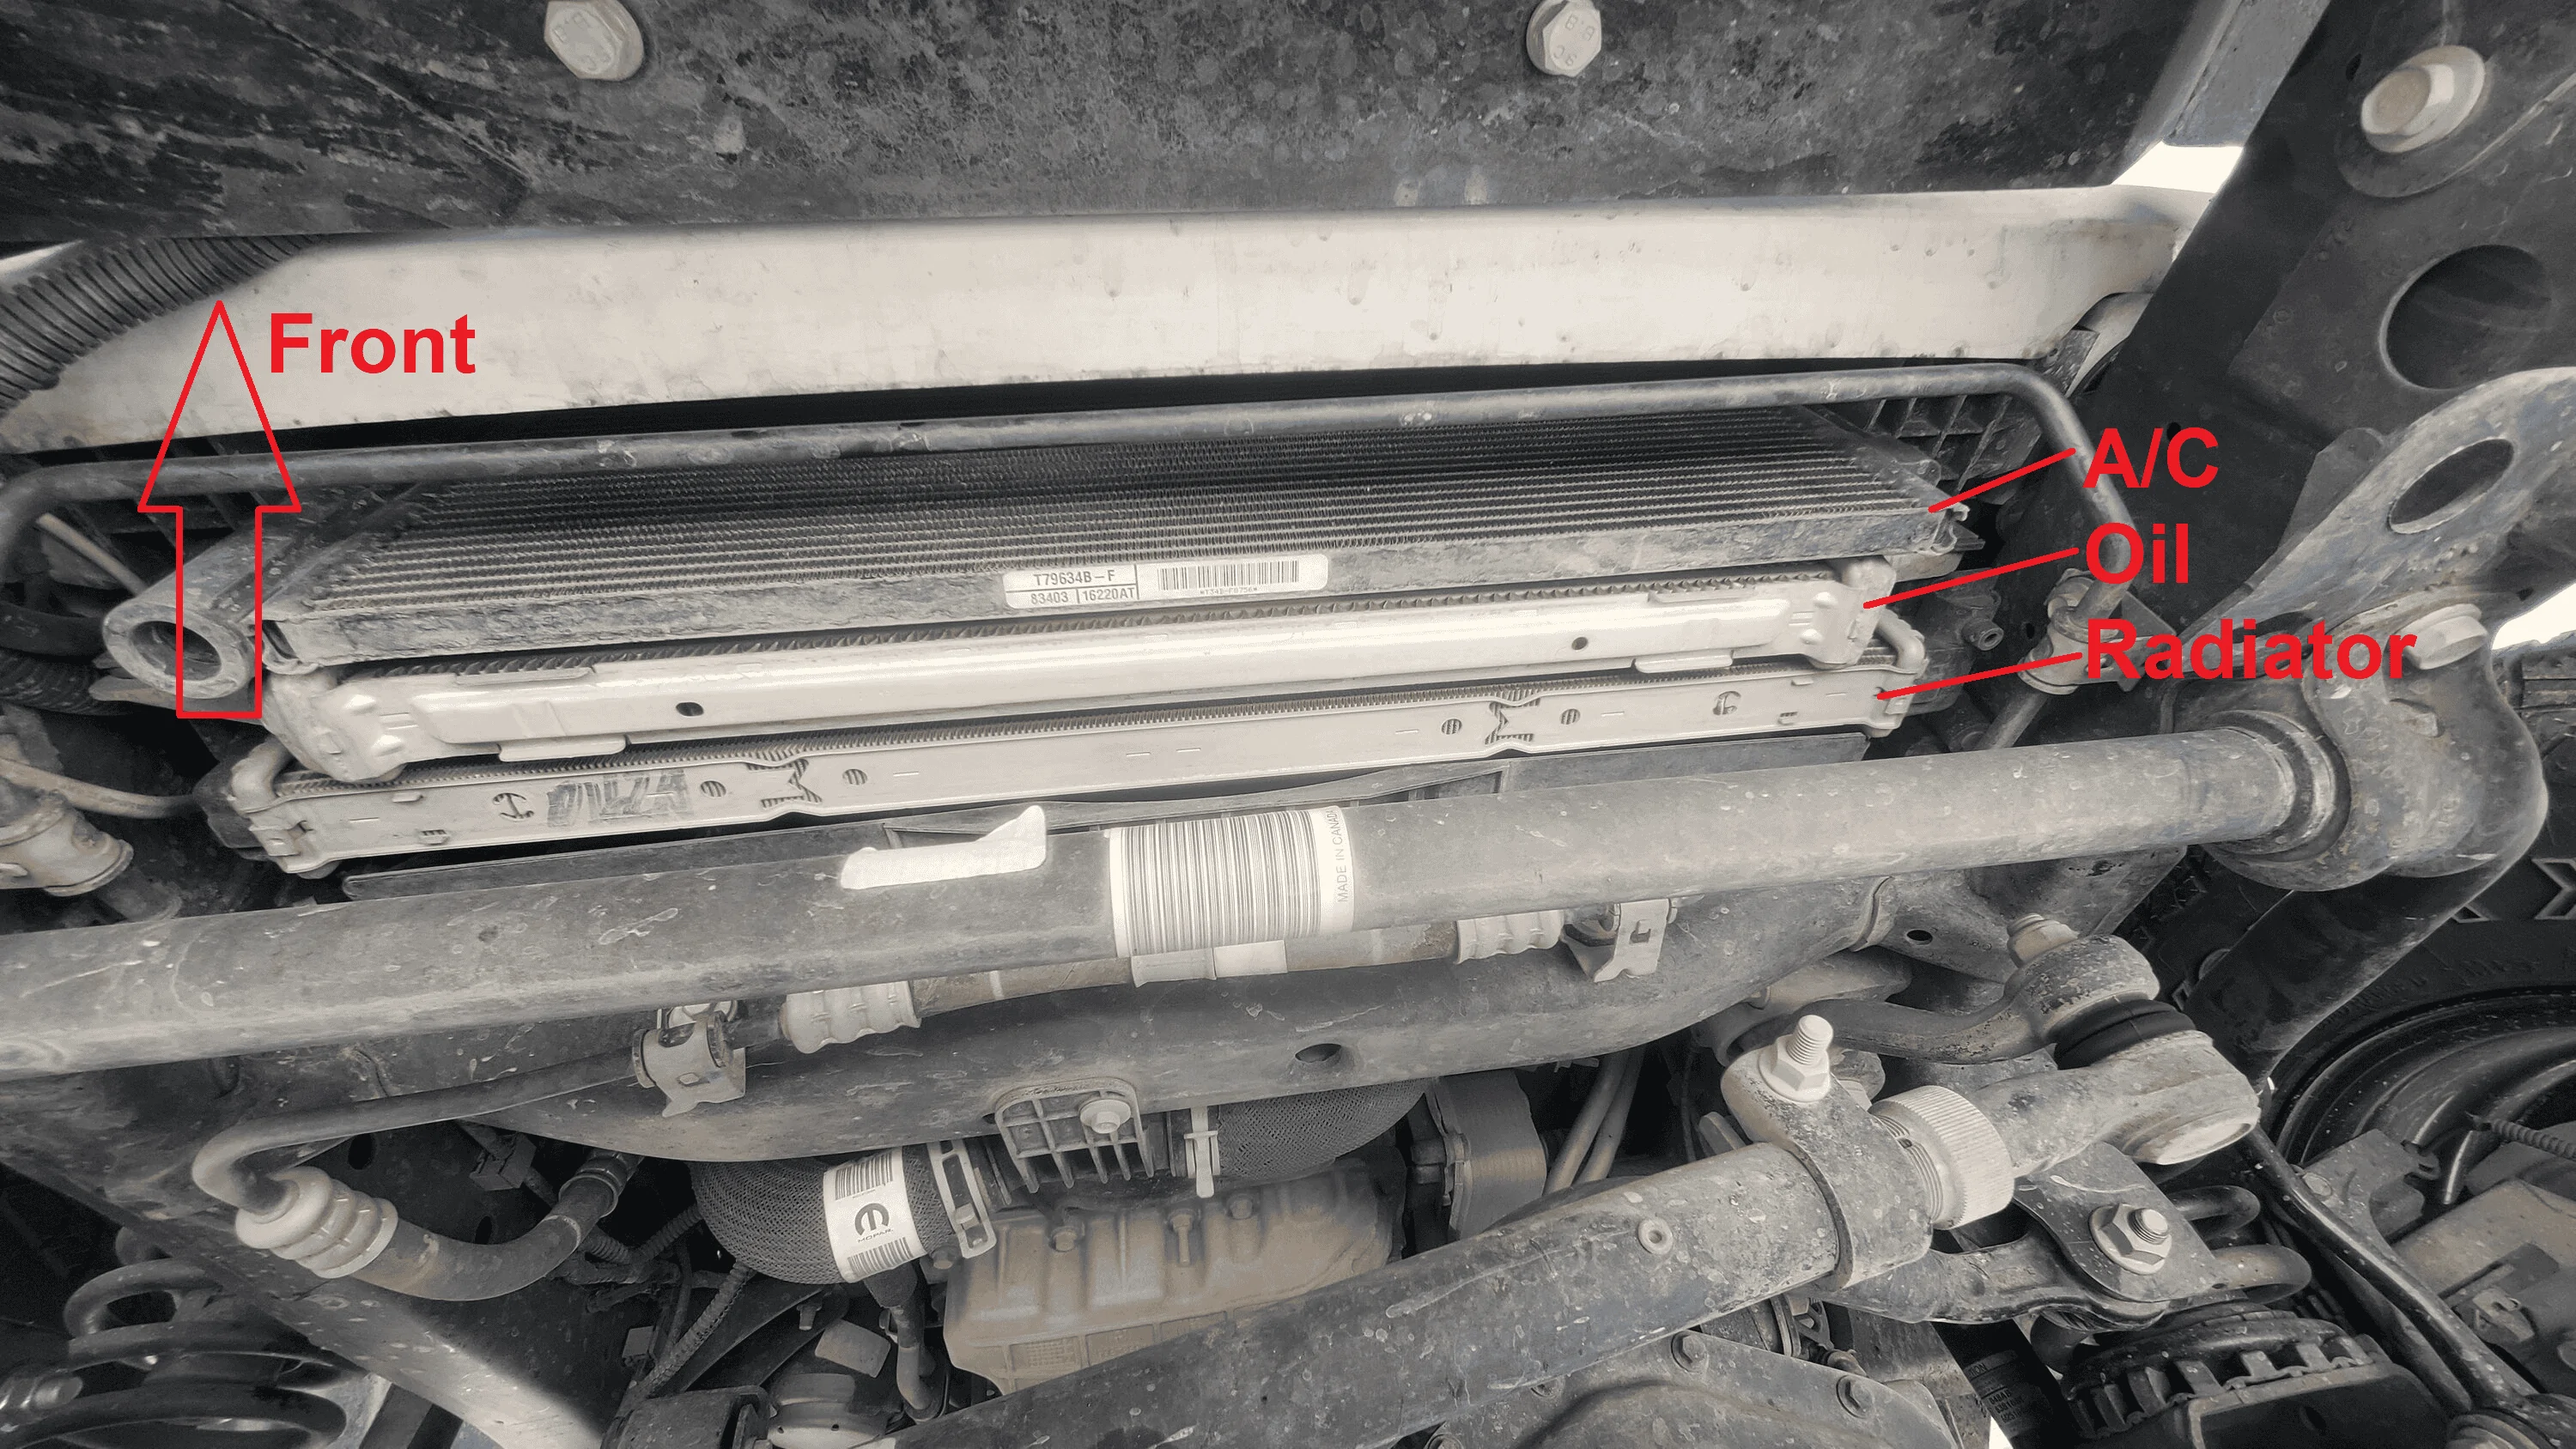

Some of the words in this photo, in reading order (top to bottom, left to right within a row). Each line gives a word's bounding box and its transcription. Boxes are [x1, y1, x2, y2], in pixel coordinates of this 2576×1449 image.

[1031, 591, 1069, 605] 83403
[1083, 587, 1135, 601] 16220AT
[1335, 849, 1346, 861] IN
[1336, 865, 1348, 902] MADE
